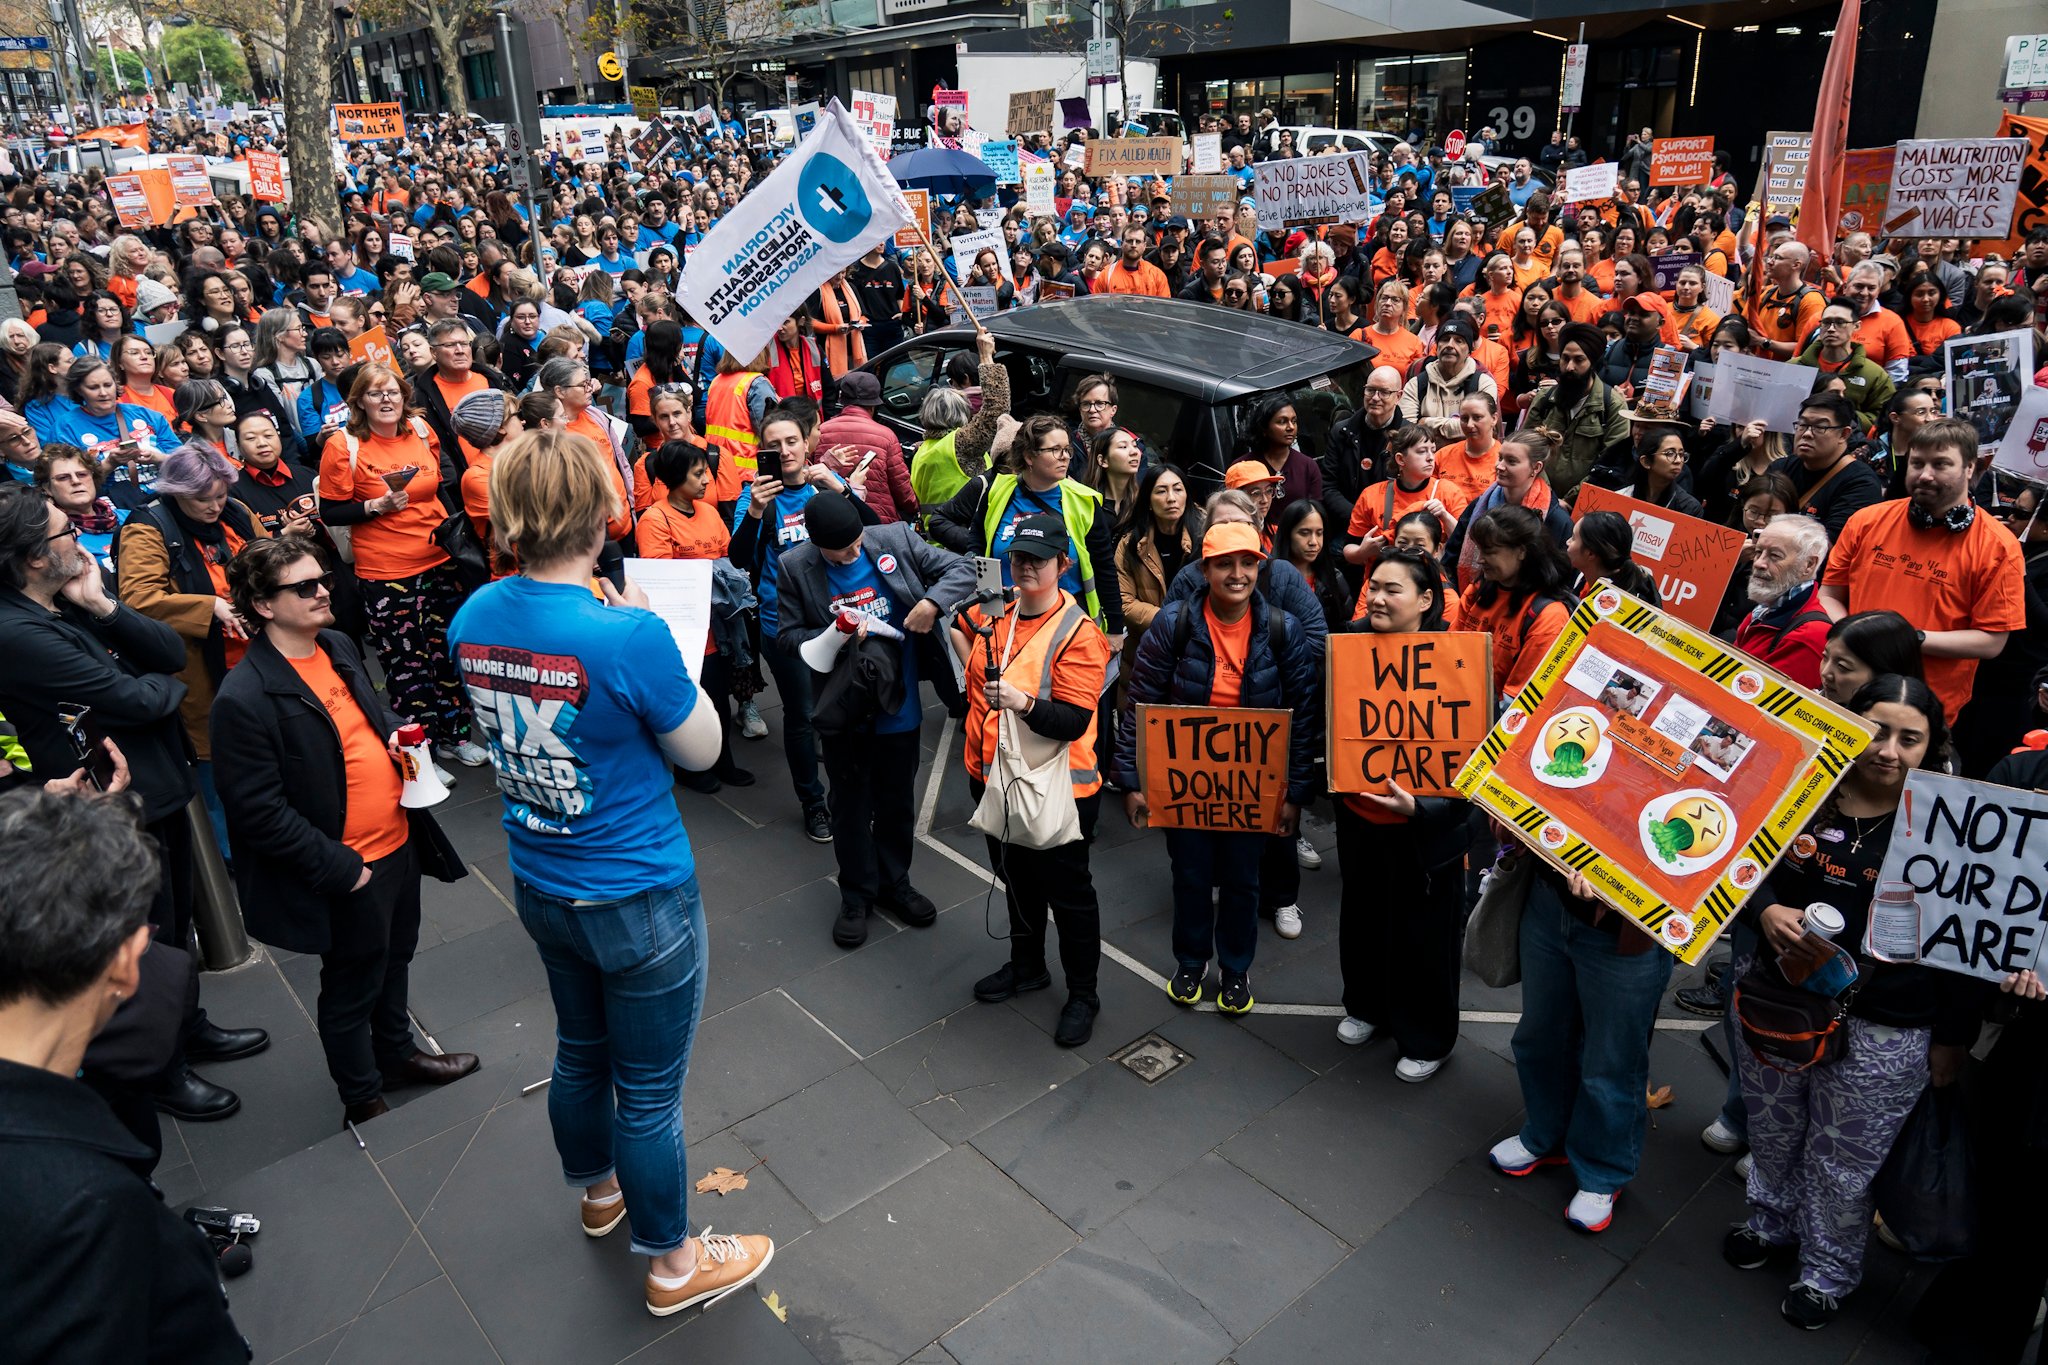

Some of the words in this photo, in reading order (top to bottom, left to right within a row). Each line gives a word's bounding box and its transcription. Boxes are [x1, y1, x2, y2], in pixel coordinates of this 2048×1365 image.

[1089, 43, 1100, 52] 2P
[1106, 42, 1112, 50] P
[2019, 41, 2029, 52] P
[2038, 40, 2048, 52] 2
[338, 106, 400, 118] NORTHERN
[854, 101, 874, 120] 99
[362, 124, 396, 134] ALTH
[873, 122, 891, 136] 90
[1488, 106, 1536, 140] 39
[904, 128, 921, 139] BLUE
[1446, 138, 1464, 152] STOP
[1661, 139, 1708, 152] SUPPORT
[1100, 149, 1116, 162] FIX
[1120, 148, 1146, 161] ALLIED
[1147, 148, 1172, 160] HEALTH
[1651, 152, 1716, 165] PSYCHOLOGISTS
[1901, 144, 2026, 166] MALNUTRITION
[1275, 165, 1294, 182] NO
[1302, 162, 1346, 180] JOKES
[1660, 164, 1676, 176] PAY
[1776, 166, 1794, 174] YOU
[1898, 167, 1956, 187] COSTS
[1966, 163, 2018, 186] MORE
[253, 180, 282, 196] BILLS
[1174, 178, 1184, 188] WE
[1192, 177, 1208, 187] HELP
[1262, 186, 1280, 202] NO
[1287, 180, 1348, 200] PRANKS
[1174, 191, 1188, 200] FIND
[1190, 191, 1206, 200] THEIR
[1896, 189, 1948, 202] THAN
[1958, 187, 2000, 203] FAIR
[1192, 203, 1202, 214] US
[1258, 209, 1278, 222] Give
[1294, 204, 1317, 218] What
[1318, 201, 1331, 216] We
[1332, 200, 1366, 214] Deserve
[1924, 204, 1998, 230] WAGES
[958, 232, 994, 244] WITHOUT
[959, 244, 1000, 257] SCIENTISTS
[972, 298, 994, 306] Matters
[364, 342, 392, 368] Pay
[1968, 356, 1980, 364] PAY
[1970, 398, 1992, 407] JACINTA
[1993, 396, 2010, 404] ALLAN
[778, 524, 810, 545] FIX
[1636, 530, 1664, 548] msav
[1668, 528, 1736, 568] SHAME
[1876, 552, 1896, 562] msav
[1906, 561, 1922, 571] ahp
[1932, 569, 1948, 579] vpa
[846, 596, 860, 604] BAND
[860, 591, 874, 600] AIDS
[1659, 574, 1698, 606] UP
[1567, 631, 1578, 646] BOSS
[1650, 625, 1666, 640] BOSS
[1665, 632, 1686, 650] CRIME
[1684, 644, 1706, 661] SCENE
[1552, 645, 1568, 665] CRIME
[461, 658, 472, 674] NO
[474, 659, 504, 676] MORE
[506, 664, 538, 683] BAND
[540, 670, 579, 688] AIDS
[1371, 642, 1438, 692] WE
[1540, 663, 1556, 682] SCENE
[467, 684, 576, 758] FIX
[1359, 696, 1471, 740] DON'T
[1619, 720, 1636, 735] msav
[1794, 708, 1812, 724] BOSS
[1811, 716, 1834, 736] CRIME
[1832, 730, 1858, 748] SCENE
[1165, 716, 1280, 765] ITCHY
[1642, 734, 1655, 746] ahp
[1661, 744, 1674, 758] vpa
[1168, 768, 1261, 801] DOWN
[1812, 772, 1824, 791] BOSS
[1488, 783, 1502, 800] CRIME
[1500, 792, 1518, 810] SCENE
[1795, 787, 1812, 813] CRIME
[1164, 803, 1262, 831] THERE
[1778, 808, 1797, 831] SCENE
[1924, 794, 2048, 859] NOT
[1826, 862, 1847, 878] vpa
[1591, 864, 1608, 882] BOSS
[1606, 875, 1626, 894] CRIME
[1623, 888, 1645, 908] SCENE
[1902, 854, 1995, 910] OUR
[2003, 876, 2048, 922] D
[1698, 916, 1710, 934] BOSS
[1681, 930, 1700, 954] CRIME
[1922, 914, 2035, 972] ARE
